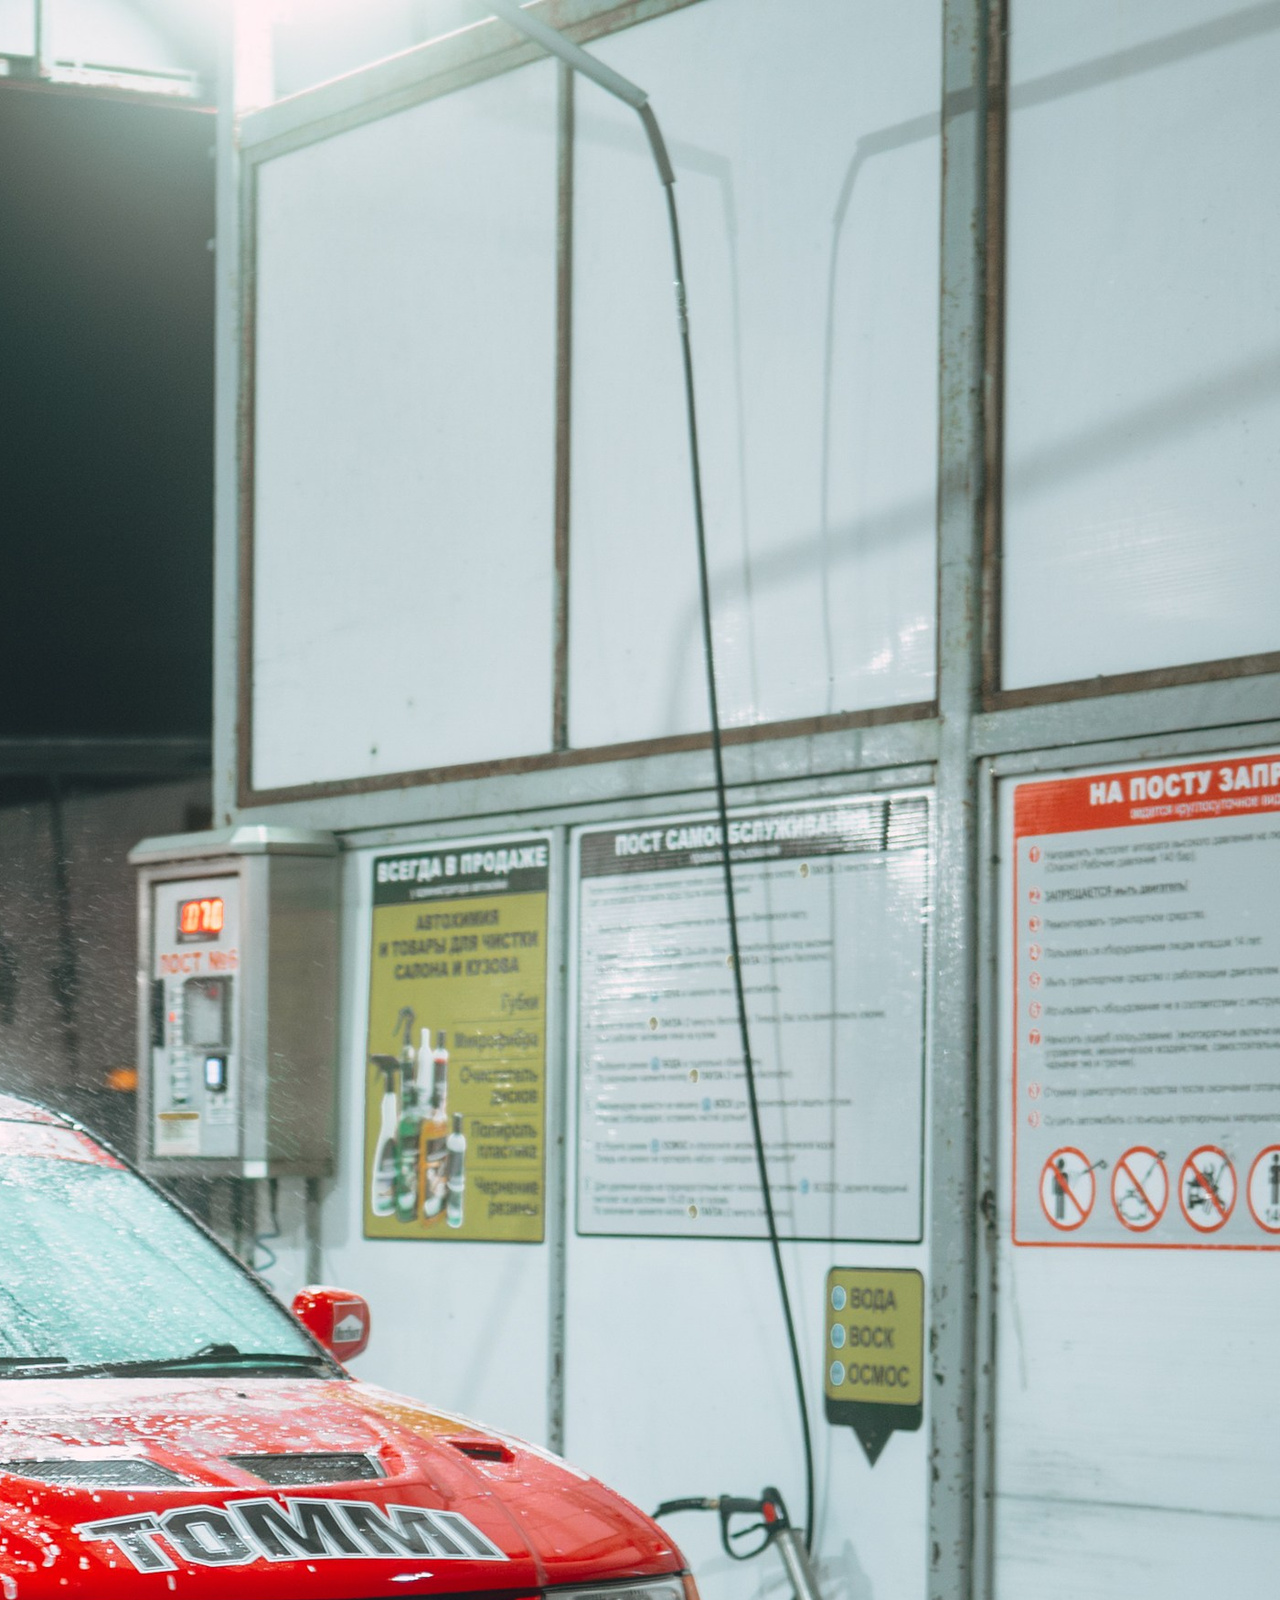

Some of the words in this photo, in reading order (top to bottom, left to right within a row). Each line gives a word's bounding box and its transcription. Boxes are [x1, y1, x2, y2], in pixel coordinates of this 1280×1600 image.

[1089, 780, 1123, 806] НА
[1130, 769, 1212, 802] ПОСТУ
[615, 831, 663, 856] ПОСТ
[377, 857, 443, 883] ВСЕГДА
[445, 855, 458, 877] В
[460, 845, 549, 875] ПРОДАЖЕ
[392, 938, 447, 957] ТОВАРЫ
[449, 935, 478, 955] ДЛЯ
[482, 931, 539, 949] ЧИСТКИ
[394, 962, 449, 981] САЛОНА
[466, 957, 520, 976] КУЗОВА
[850, 1287, 896, 1312] ВОДА
[849, 1324, 895, 1349] ВОСК
[848, 1362, 910, 1388] ОСМОС
[73, 1497, 512, 1574] TOMMI
